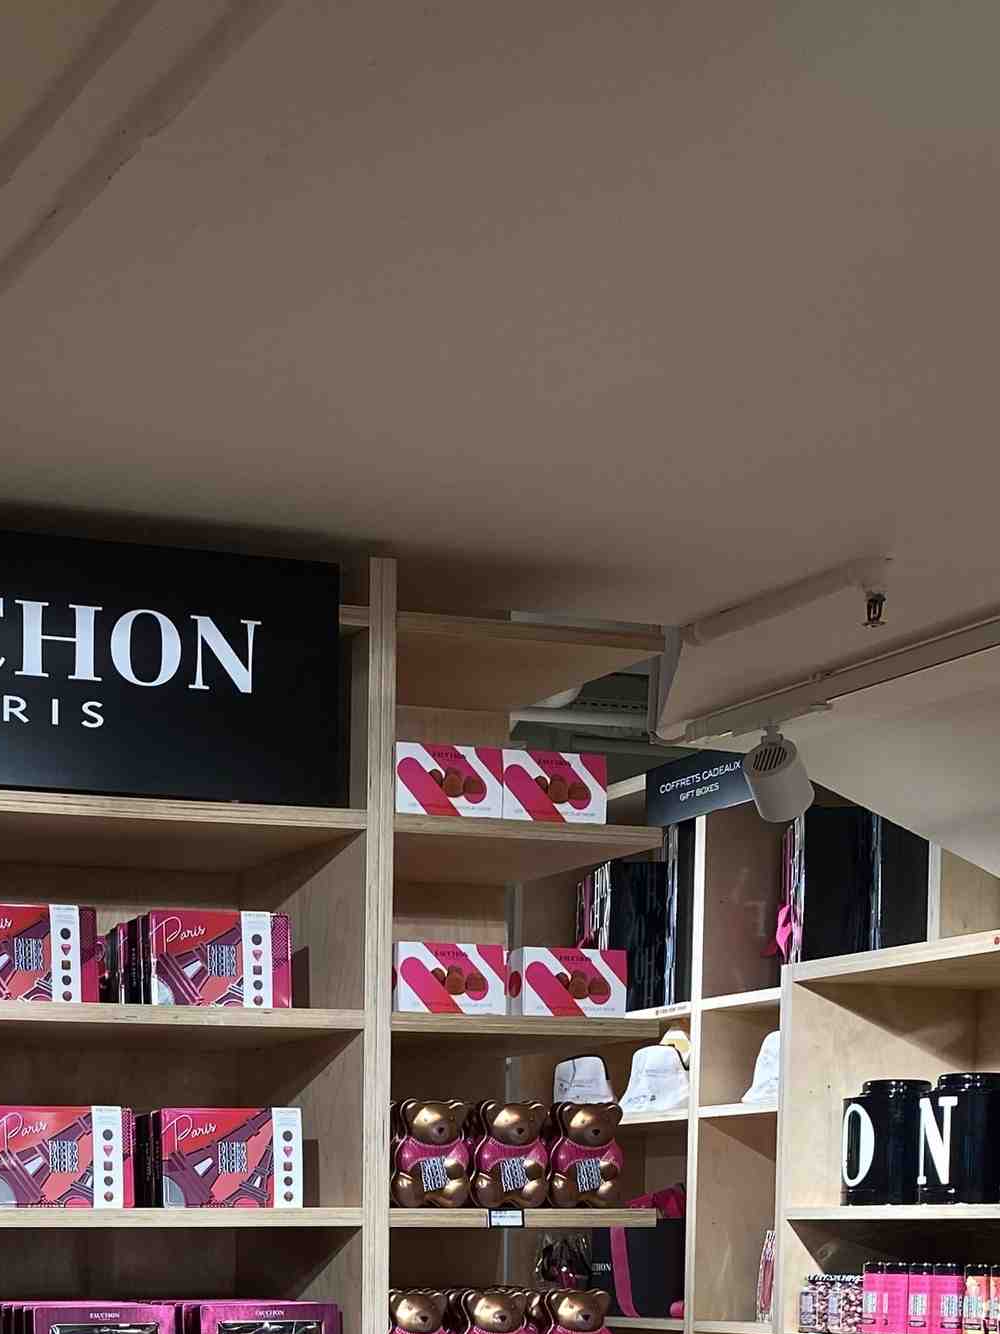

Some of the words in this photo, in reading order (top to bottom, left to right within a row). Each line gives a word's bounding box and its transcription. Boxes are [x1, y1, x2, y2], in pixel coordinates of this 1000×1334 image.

[660, 773, 701, 793] COFFRETS
[701, 760, 741, 780] CADEAUX
[680, 789, 695, 801] GIFT
[696, 782, 720, 796] BOXES
[152, 916, 206, 951] Paris
[163, 1114, 217, 1151] Paris
[842, 1103, 875, 1187] O
[916, 1095, 959, 1185] N
